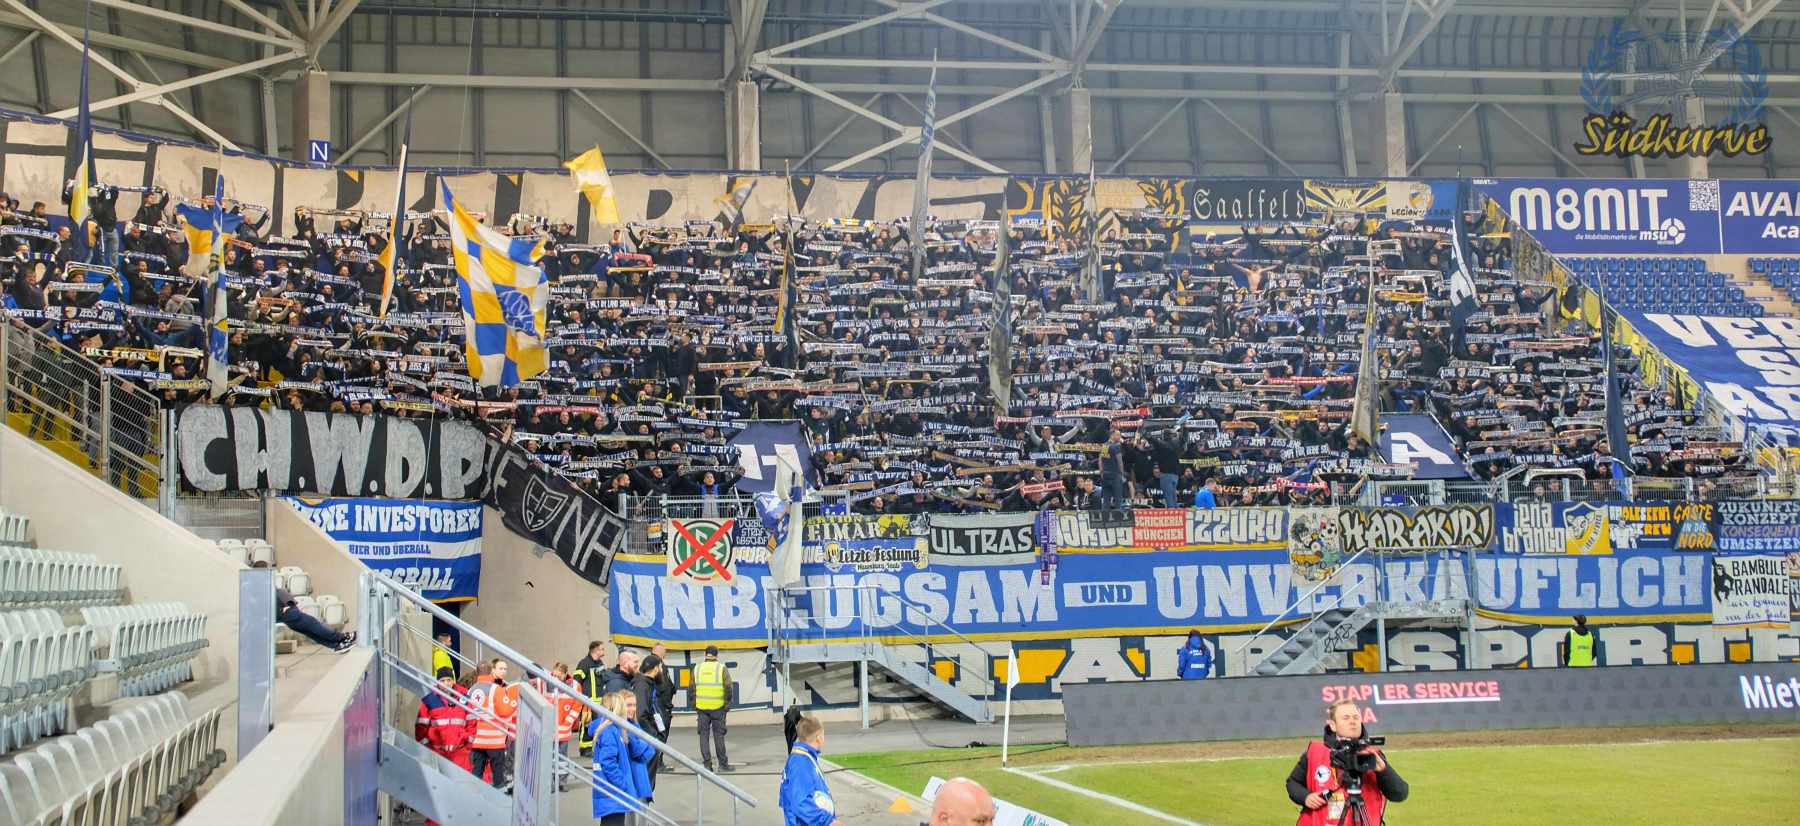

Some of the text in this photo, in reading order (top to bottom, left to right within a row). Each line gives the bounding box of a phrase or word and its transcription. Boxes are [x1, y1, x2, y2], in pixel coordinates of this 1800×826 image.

[311, 141, 328, 160] N
[1510, 187, 1668, 231] M8MIT
[1639, 231, 1668, 242] msu
[1761, 222, 1800, 239] Aca
[1390, 431, 1455, 464] A
[354, 504, 482, 535] INVESTOREN
[1339, 507, 1491, 550] HARAKIRI
[1722, 512, 1798, 526] KONZEPT
[372, 543, 391, 556] UND
[392, 541, 432, 556] ÜBERALL
[930, 526, 1033, 555] ULTRAS
[1678, 532, 1714, 549] NORD
[1719, 537, 1800, 550] UMSETZEN
[875, 547, 920, 564] Festung
[1732, 559, 1787, 577] BAMBULE
[614, 553, 1704, 631] UNBEUGSAM UND UNVERKÄUFLICH
[1734, 577, 1789, 597] RANDALE
[1322, 681, 1499, 703] STAPLER SERVICE
